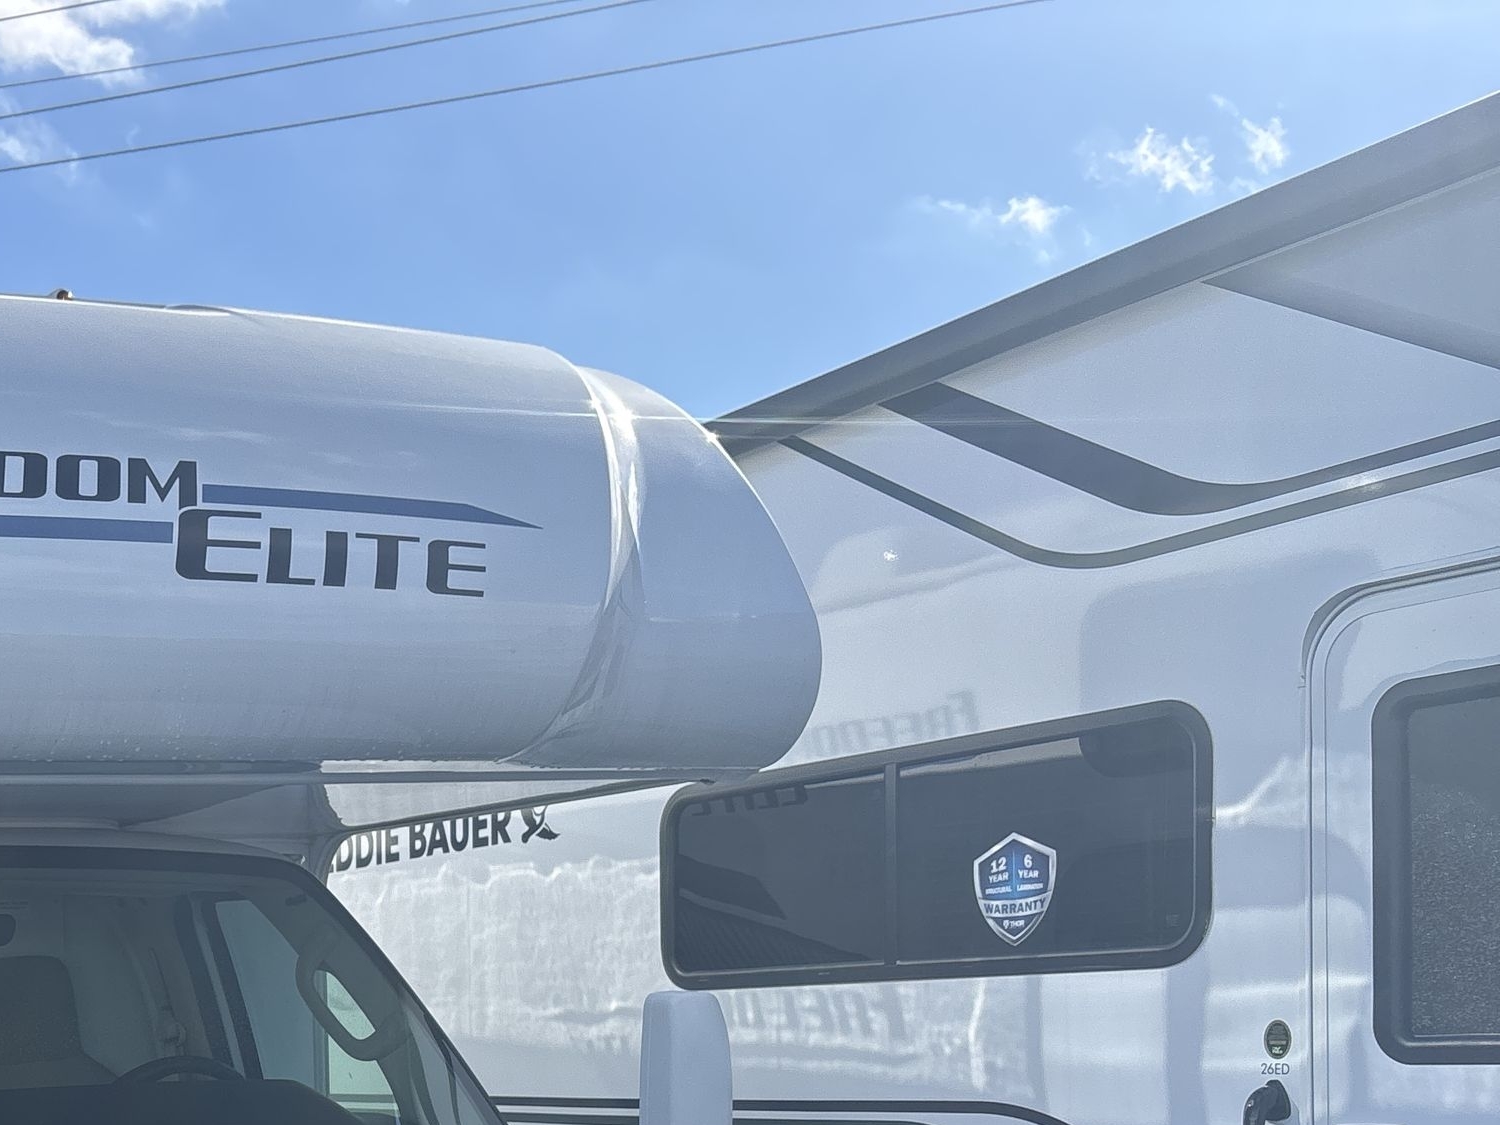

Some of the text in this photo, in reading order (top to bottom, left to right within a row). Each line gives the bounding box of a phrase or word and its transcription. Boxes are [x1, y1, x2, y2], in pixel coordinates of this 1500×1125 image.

[175, 508, 487, 598] ELITE
[328, 811, 512, 874] DDIE BAUER
[990, 856, 1007, 874] 12
[1023, 854, 1033, 868] 6
[988, 872, 1009, 884] YEAR
[1017, 869, 1039, 879] YEAR
[984, 897, 1046, 914] WARRANTY
[1260, 1062, 1291, 1075] 26ED
